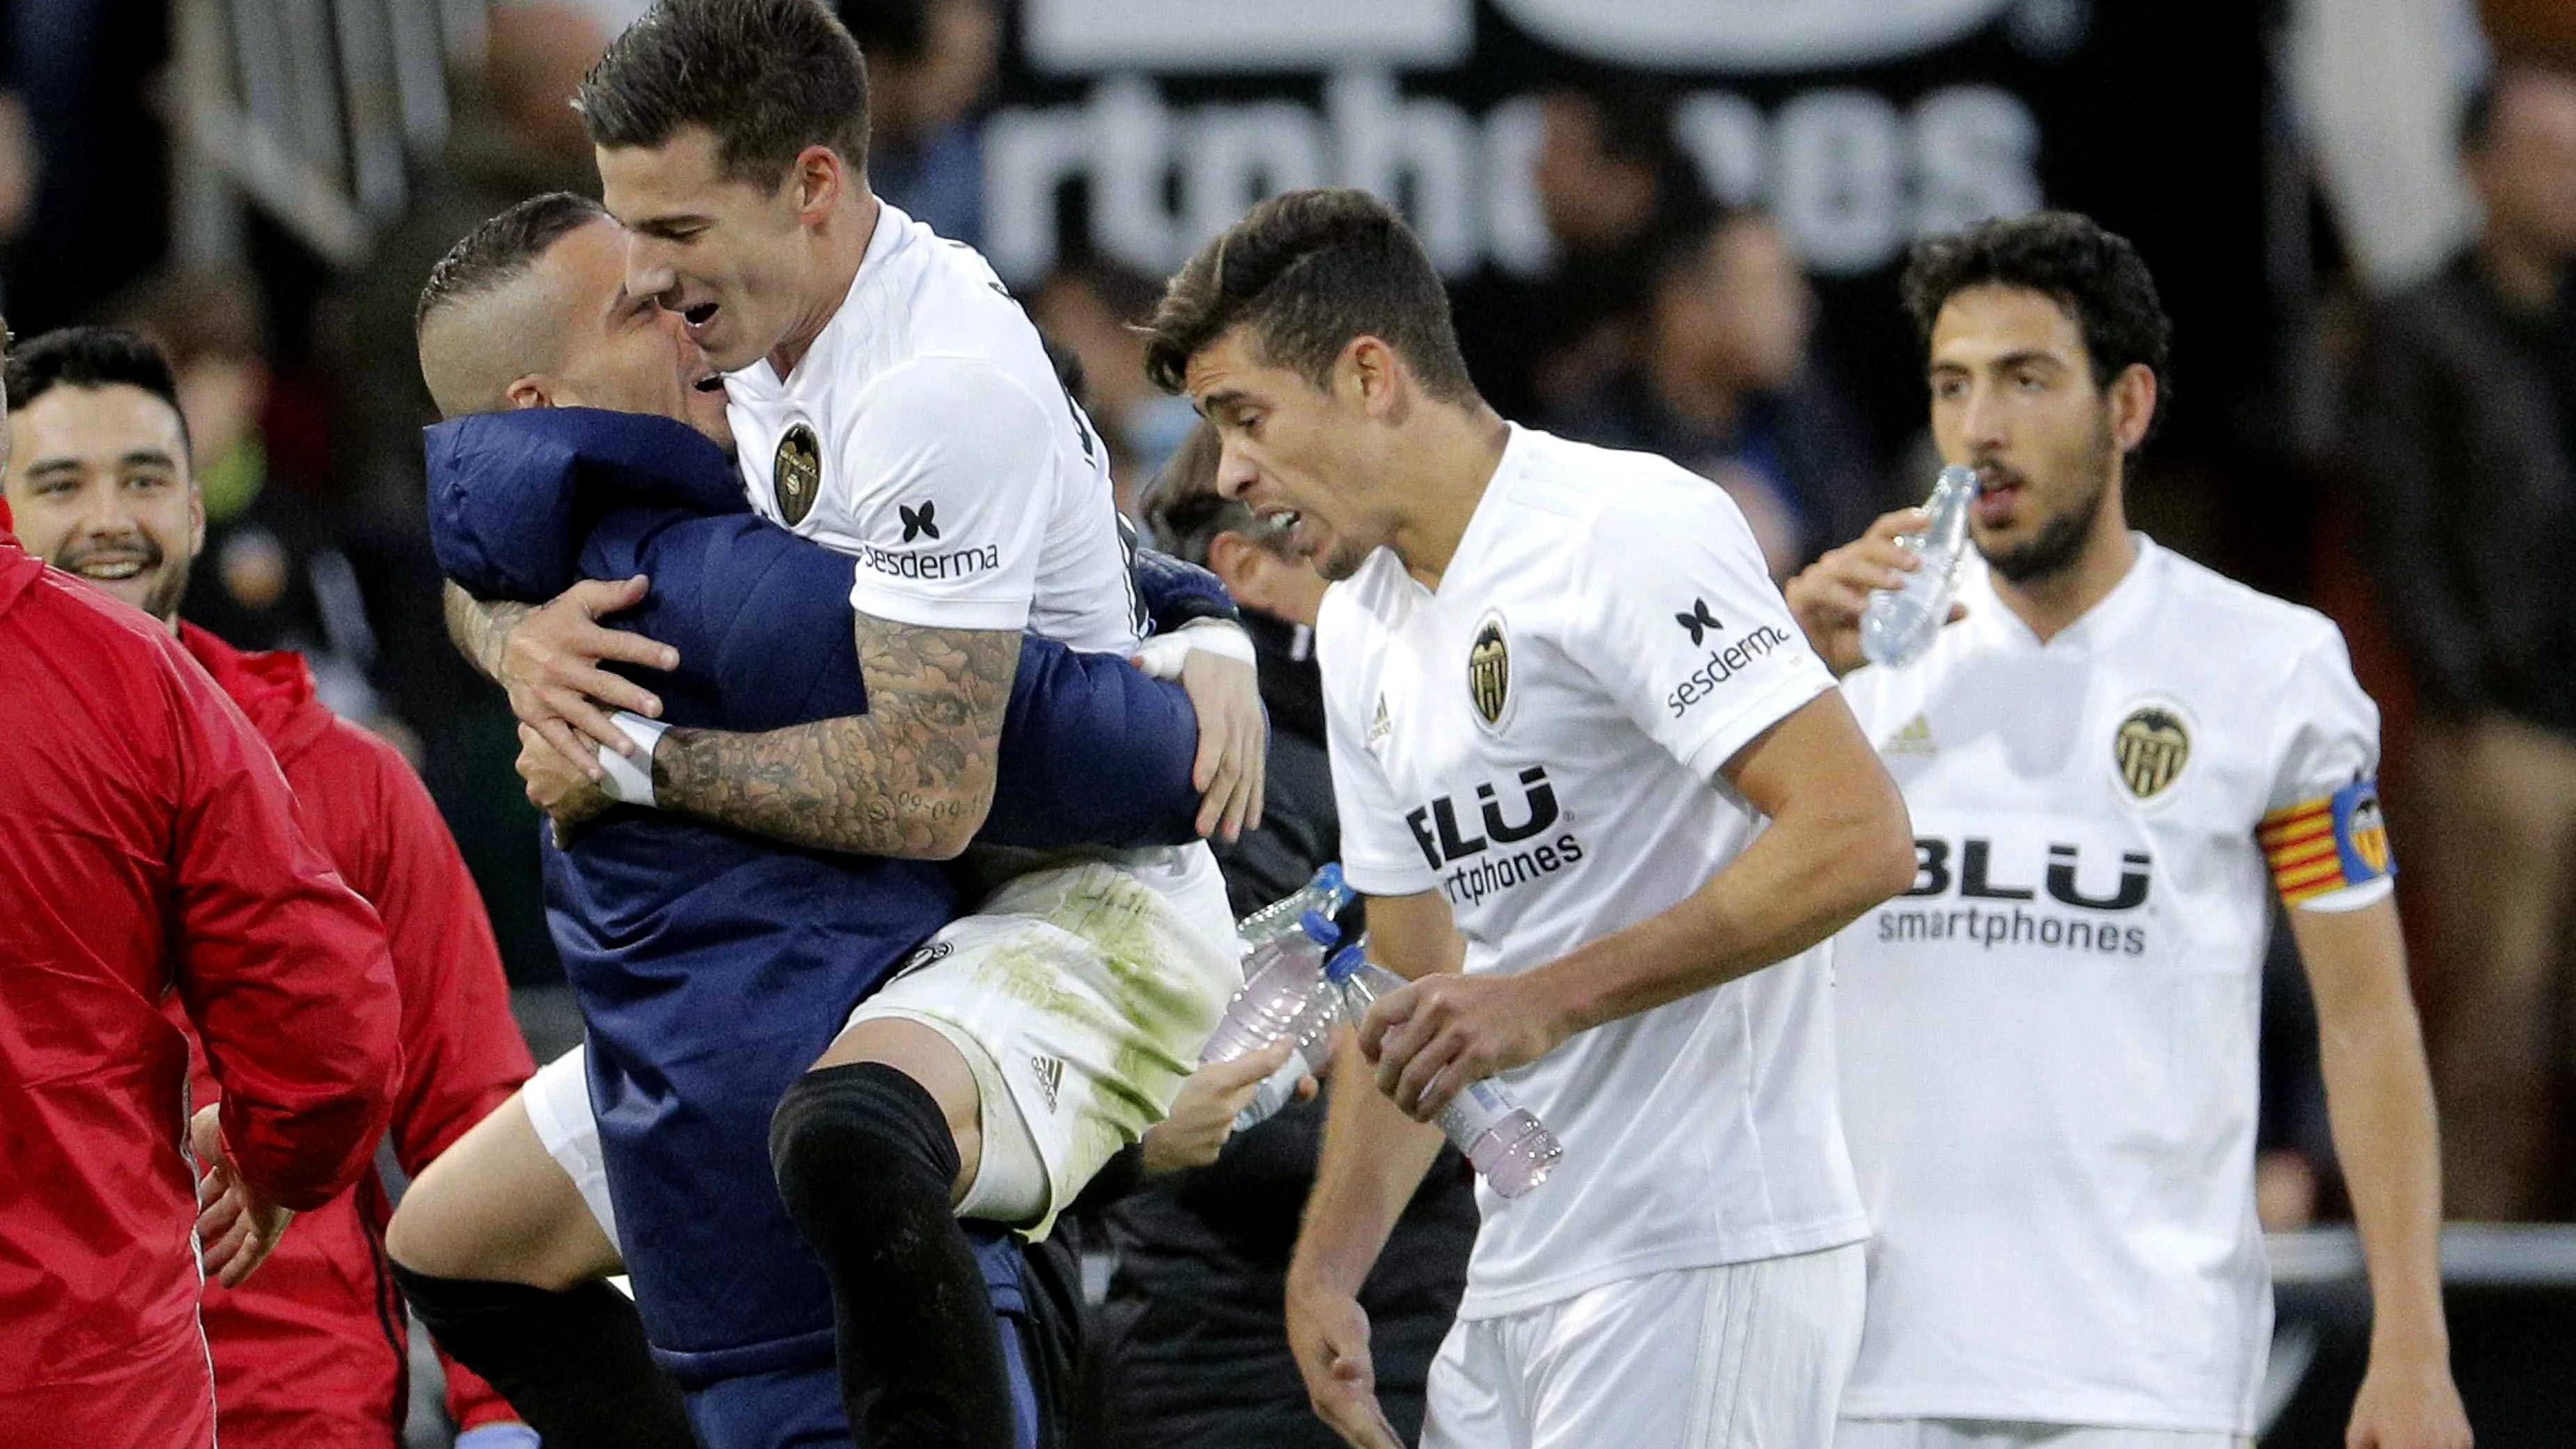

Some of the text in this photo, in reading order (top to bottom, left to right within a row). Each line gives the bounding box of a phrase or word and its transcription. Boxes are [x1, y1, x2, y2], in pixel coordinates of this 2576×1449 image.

[865, 545, 999, 579] sesderma
[1443, 834, 1583, 907] rtphones
[1878, 907, 2146, 955] smartphones
